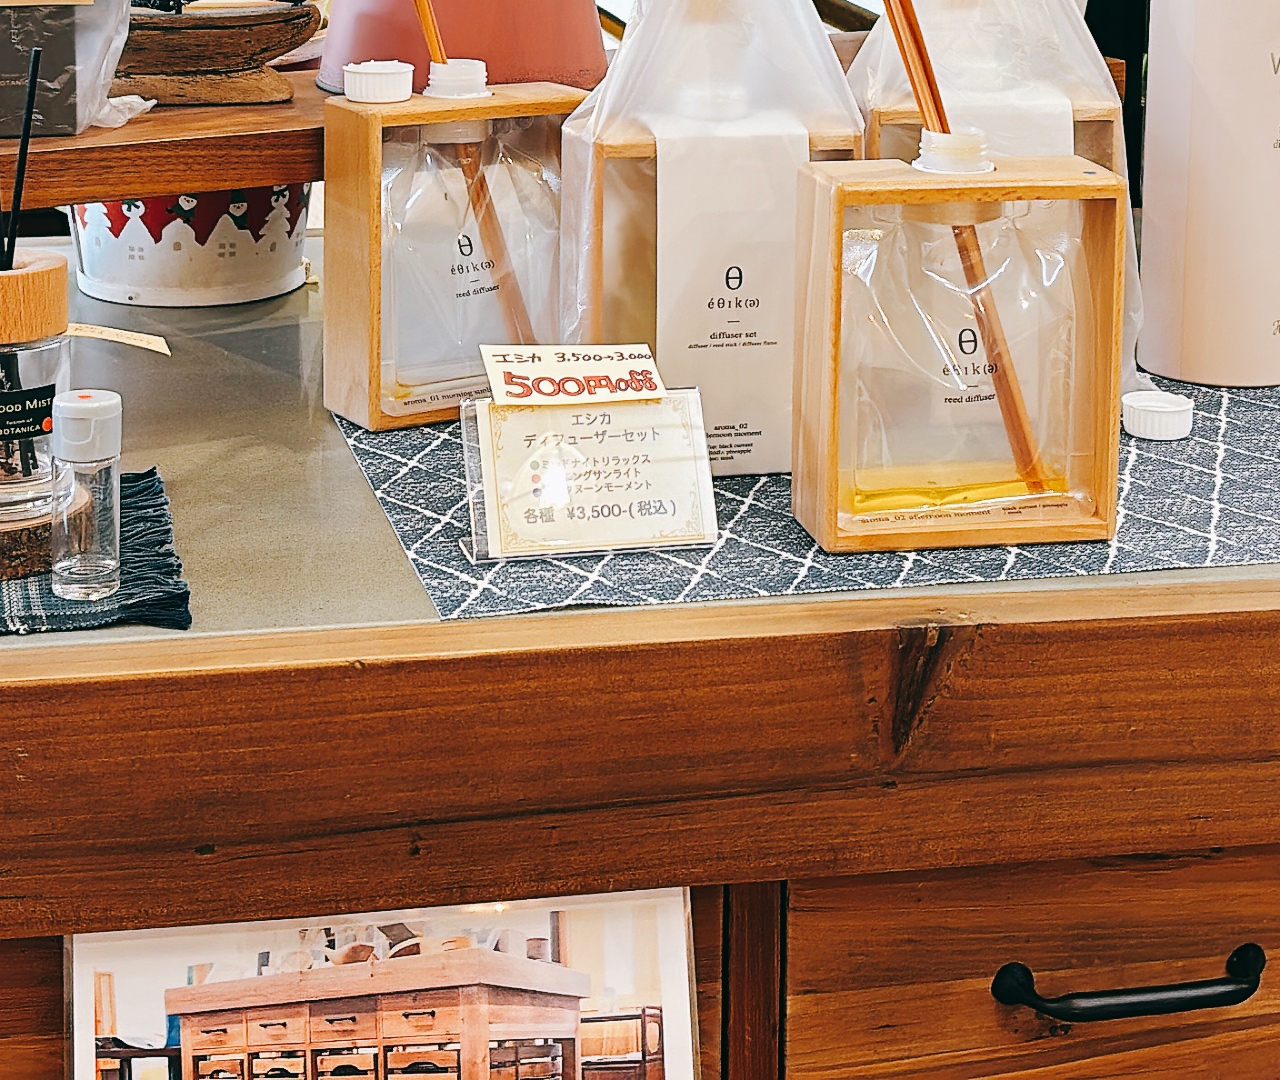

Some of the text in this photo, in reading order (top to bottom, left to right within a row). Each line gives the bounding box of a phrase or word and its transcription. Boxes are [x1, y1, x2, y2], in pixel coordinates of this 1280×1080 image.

[456, 284, 500, 299] reed diffuser
[710, 331, 742, 340] diffuser
[944, 393, 996, 404] reed diffuser
[571, 412, 611, 426] エシカ
[541, 454, 651, 470] ミドナイトリラックス
[524, 506, 555, 524] 各種
